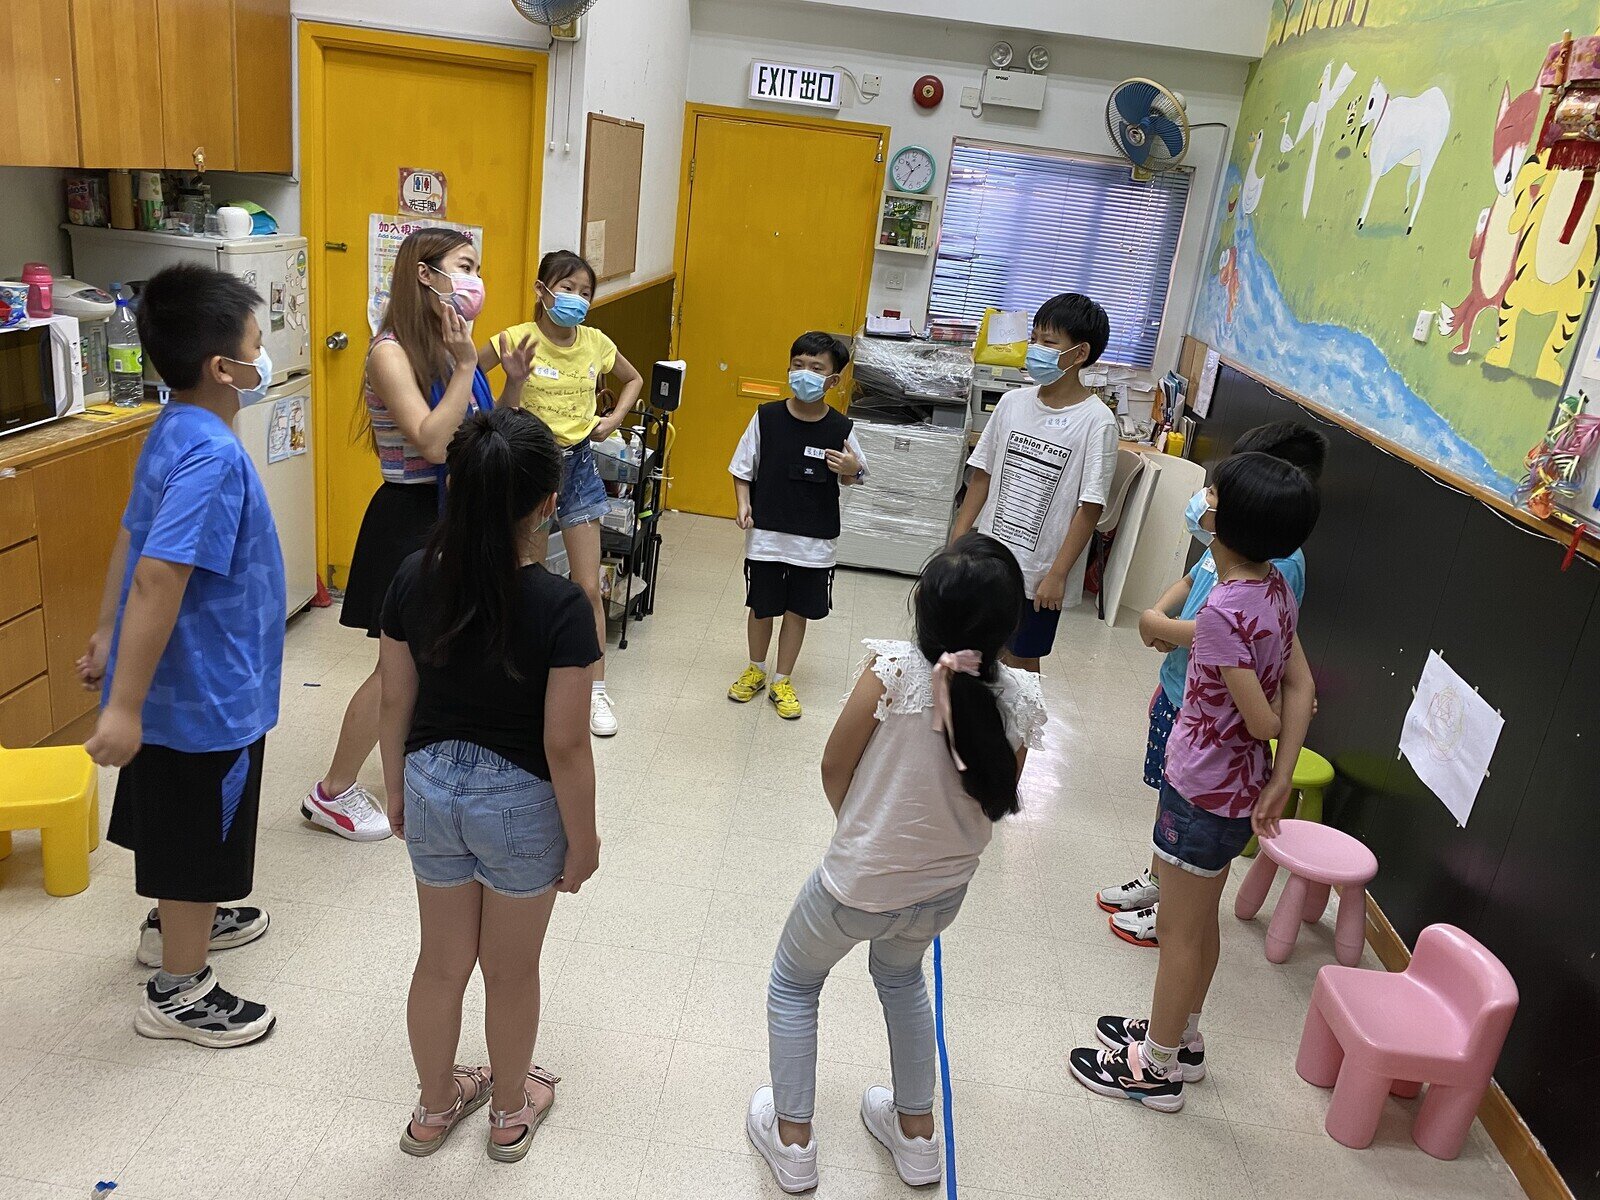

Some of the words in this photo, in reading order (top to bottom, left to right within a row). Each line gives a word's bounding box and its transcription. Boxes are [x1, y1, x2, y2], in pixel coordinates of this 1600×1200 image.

[758, 66, 798, 98] EXIT
[800, 71, 835, 103] 出口
[1010, 433, 1041, 450] Fashion
[1043, 444, 1068, 459] Facto
[1168, 832, 1176, 842] S
